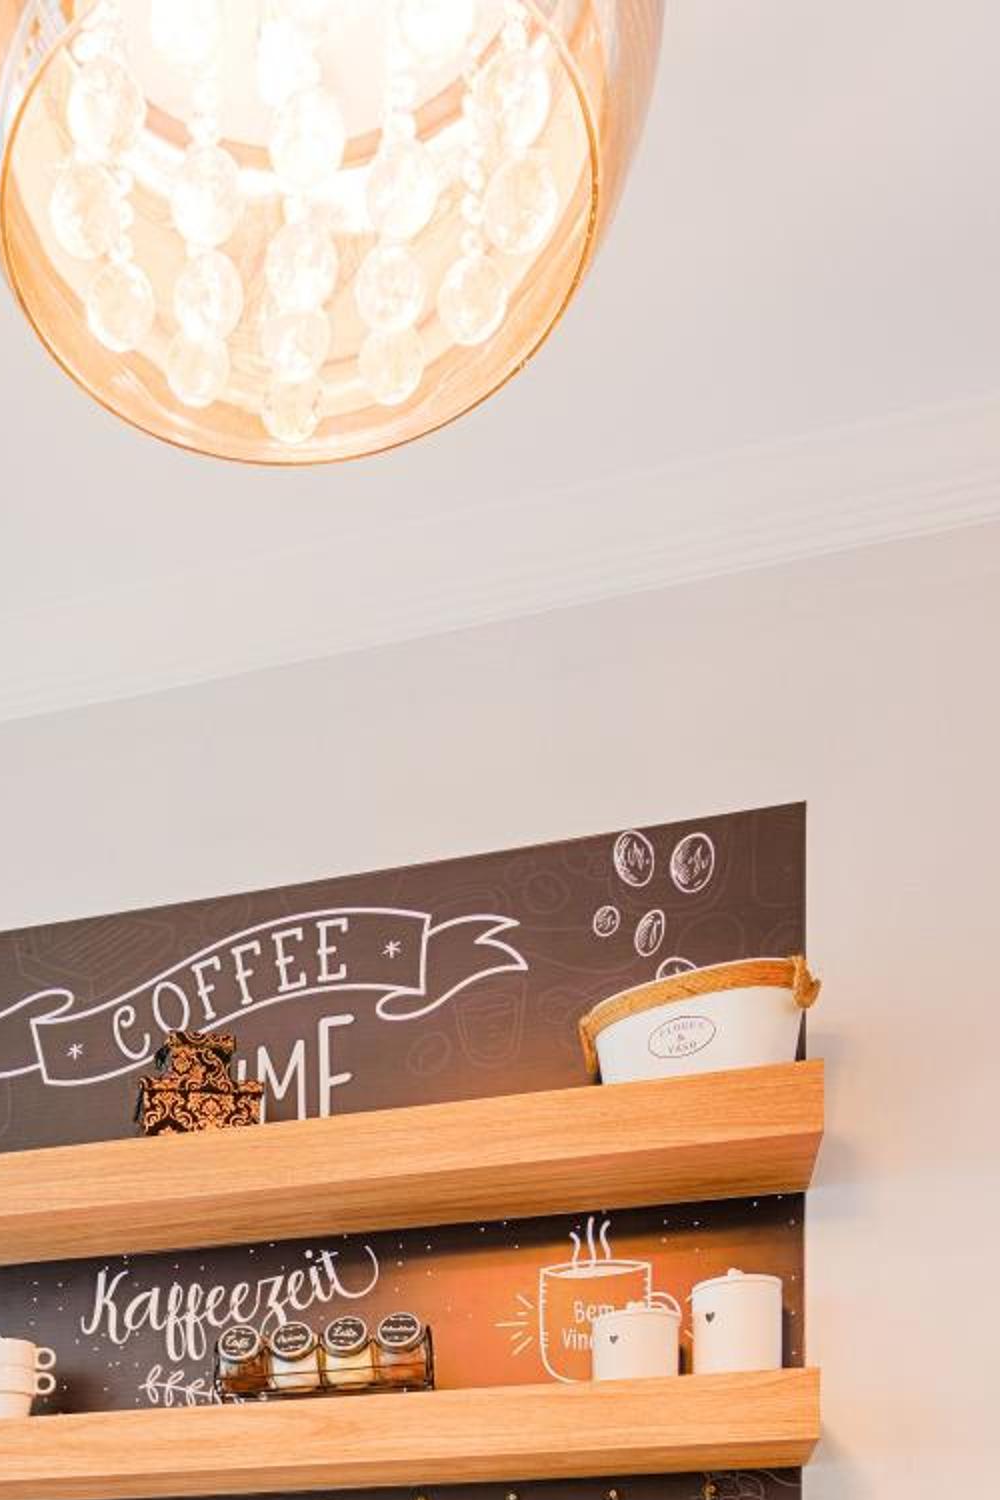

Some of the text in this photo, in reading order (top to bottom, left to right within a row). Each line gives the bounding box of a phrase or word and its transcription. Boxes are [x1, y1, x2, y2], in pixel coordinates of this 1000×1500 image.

[113, 918, 349, 1060] COFFEE
[238, 1014, 354, 1124] ME
[81, 1246, 380, 1361] Kaffeezeit
